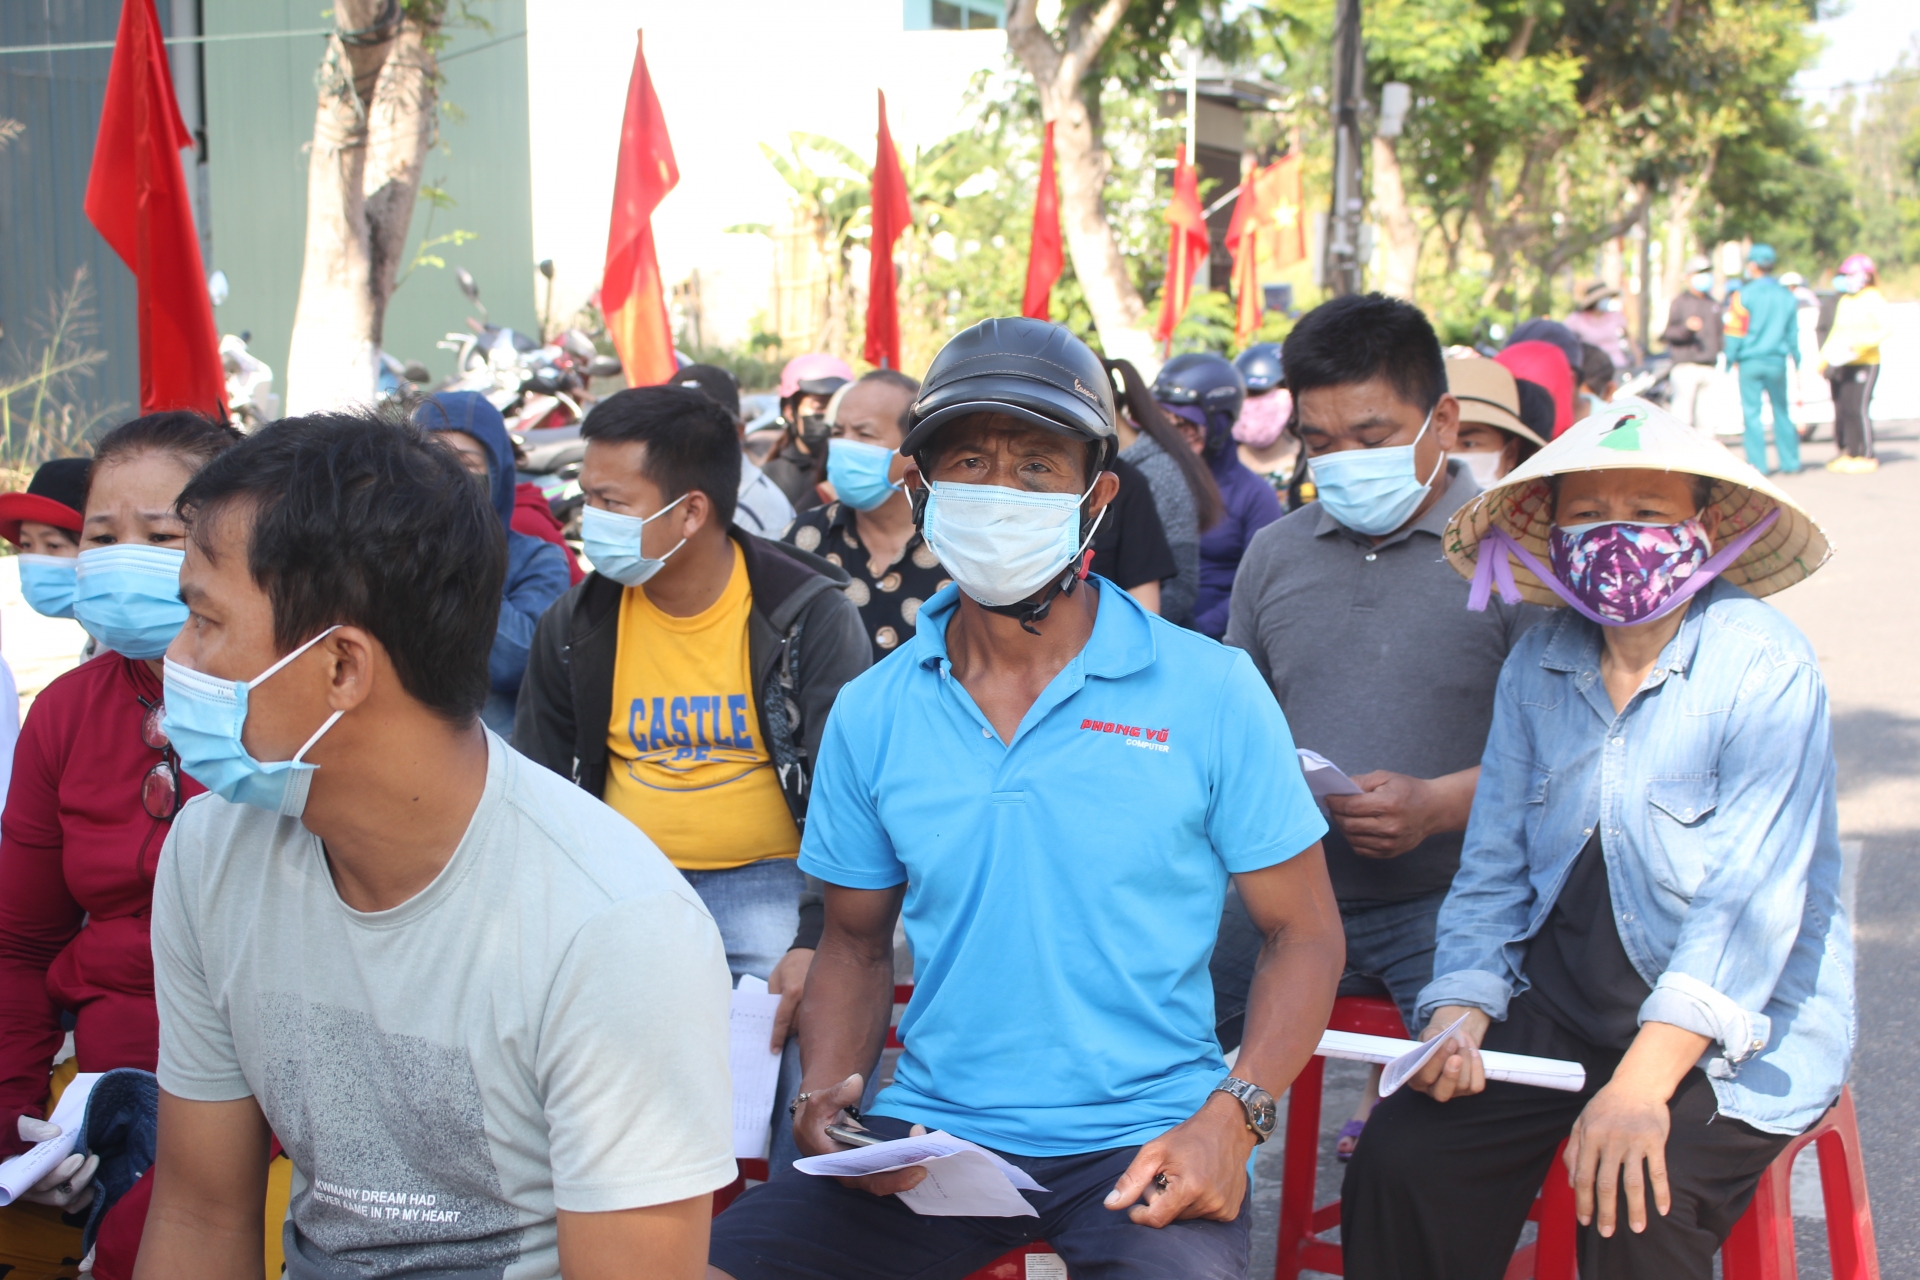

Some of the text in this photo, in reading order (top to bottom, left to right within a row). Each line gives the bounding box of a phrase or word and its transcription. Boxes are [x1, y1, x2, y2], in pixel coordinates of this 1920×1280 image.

[628, 694, 754, 752] CASTLE
[1081, 719, 1169, 743] PHONG VŨ
[1126, 738, 1170, 753] COMPUTER
[361, 1190, 407, 1204] DREAM
[409, 1193, 436, 1206] HAD
[370, 1206, 382, 1218] IN
[385, 1207, 400, 1220] TP
[402, 1208, 420, 1221] MY
[421, 1209, 461, 1223] HEART
